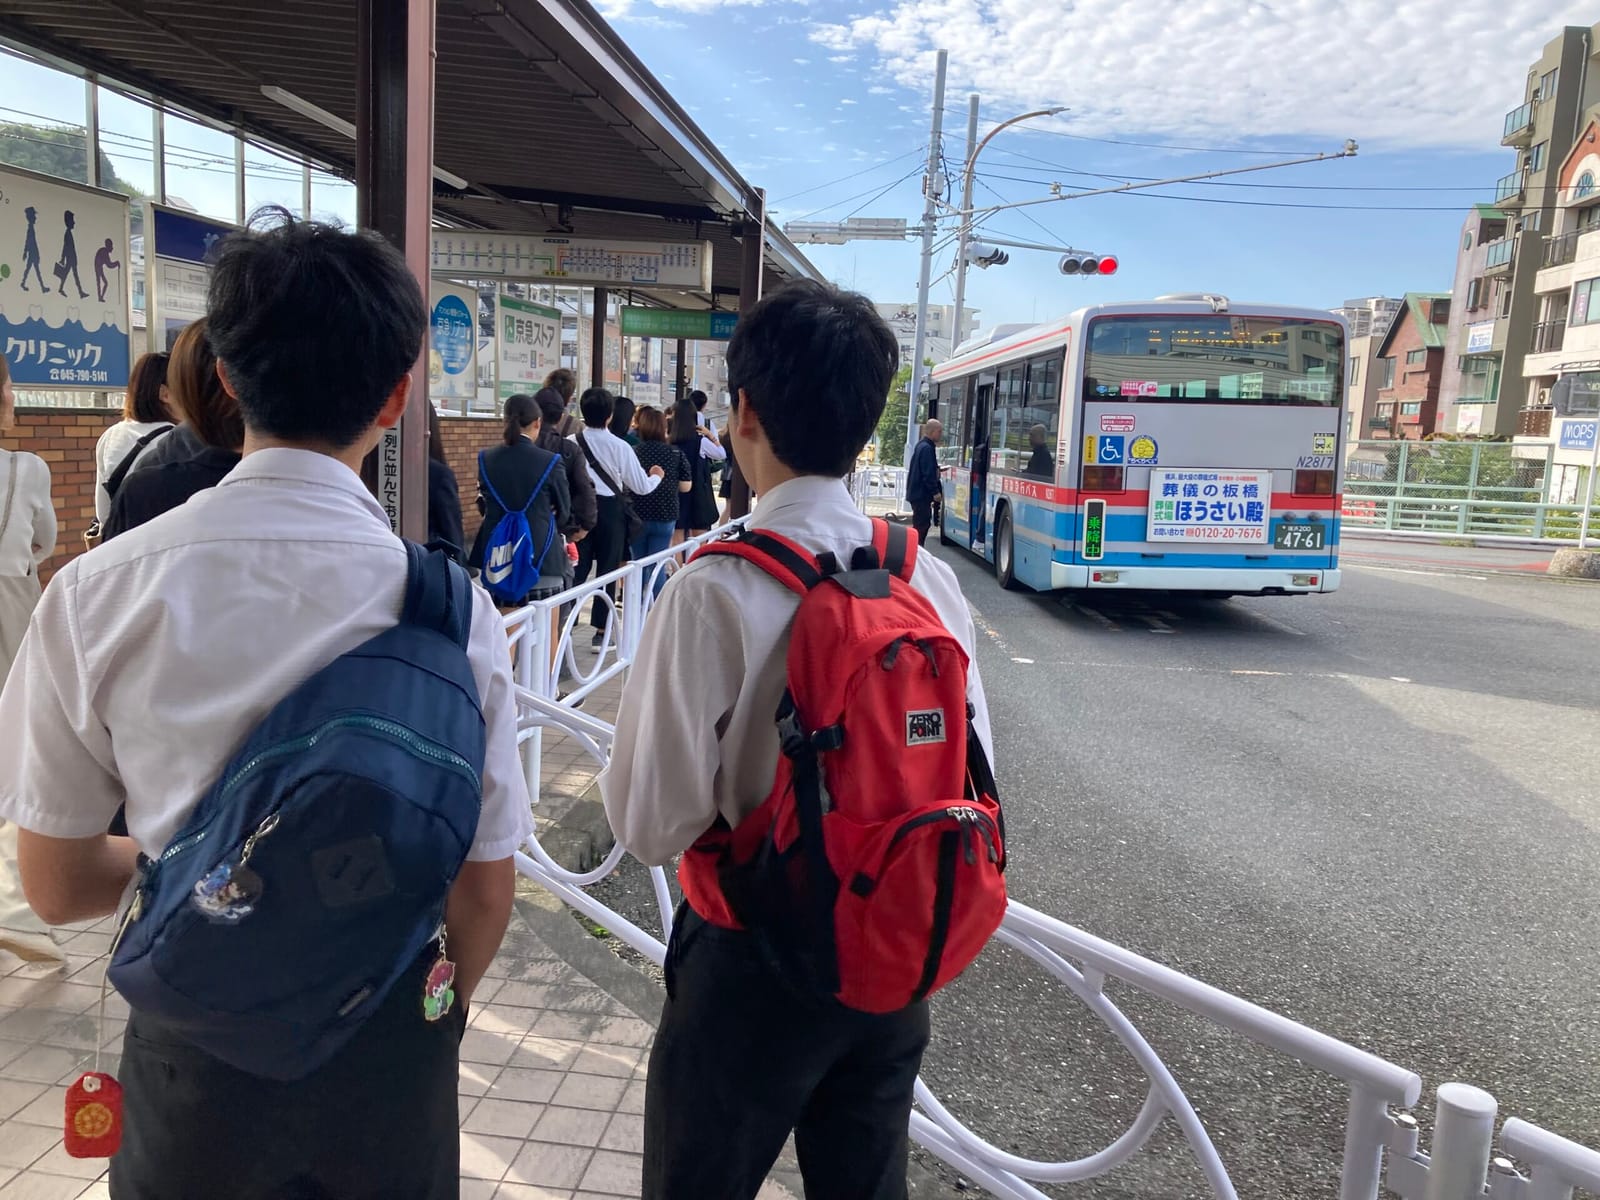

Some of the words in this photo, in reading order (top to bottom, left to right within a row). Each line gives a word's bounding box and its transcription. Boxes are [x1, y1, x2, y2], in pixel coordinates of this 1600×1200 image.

[516, 319, 556, 348] 京急ストア
[5, 337, 102, 368] クリニック
[60, 368, 108, 382] 045-790-5141
[1564, 423, 1594, 440] MOPS
[1296, 456, 1334, 468] N2817
[1175, 500, 1264, 522] ほうさい殿
[1086, 516, 1102, 557] 乗降中
[1283, 532, 1321, 548] 47-61
[908, 712, 942, 725] ZERO
[909, 723, 943, 739] POINT
